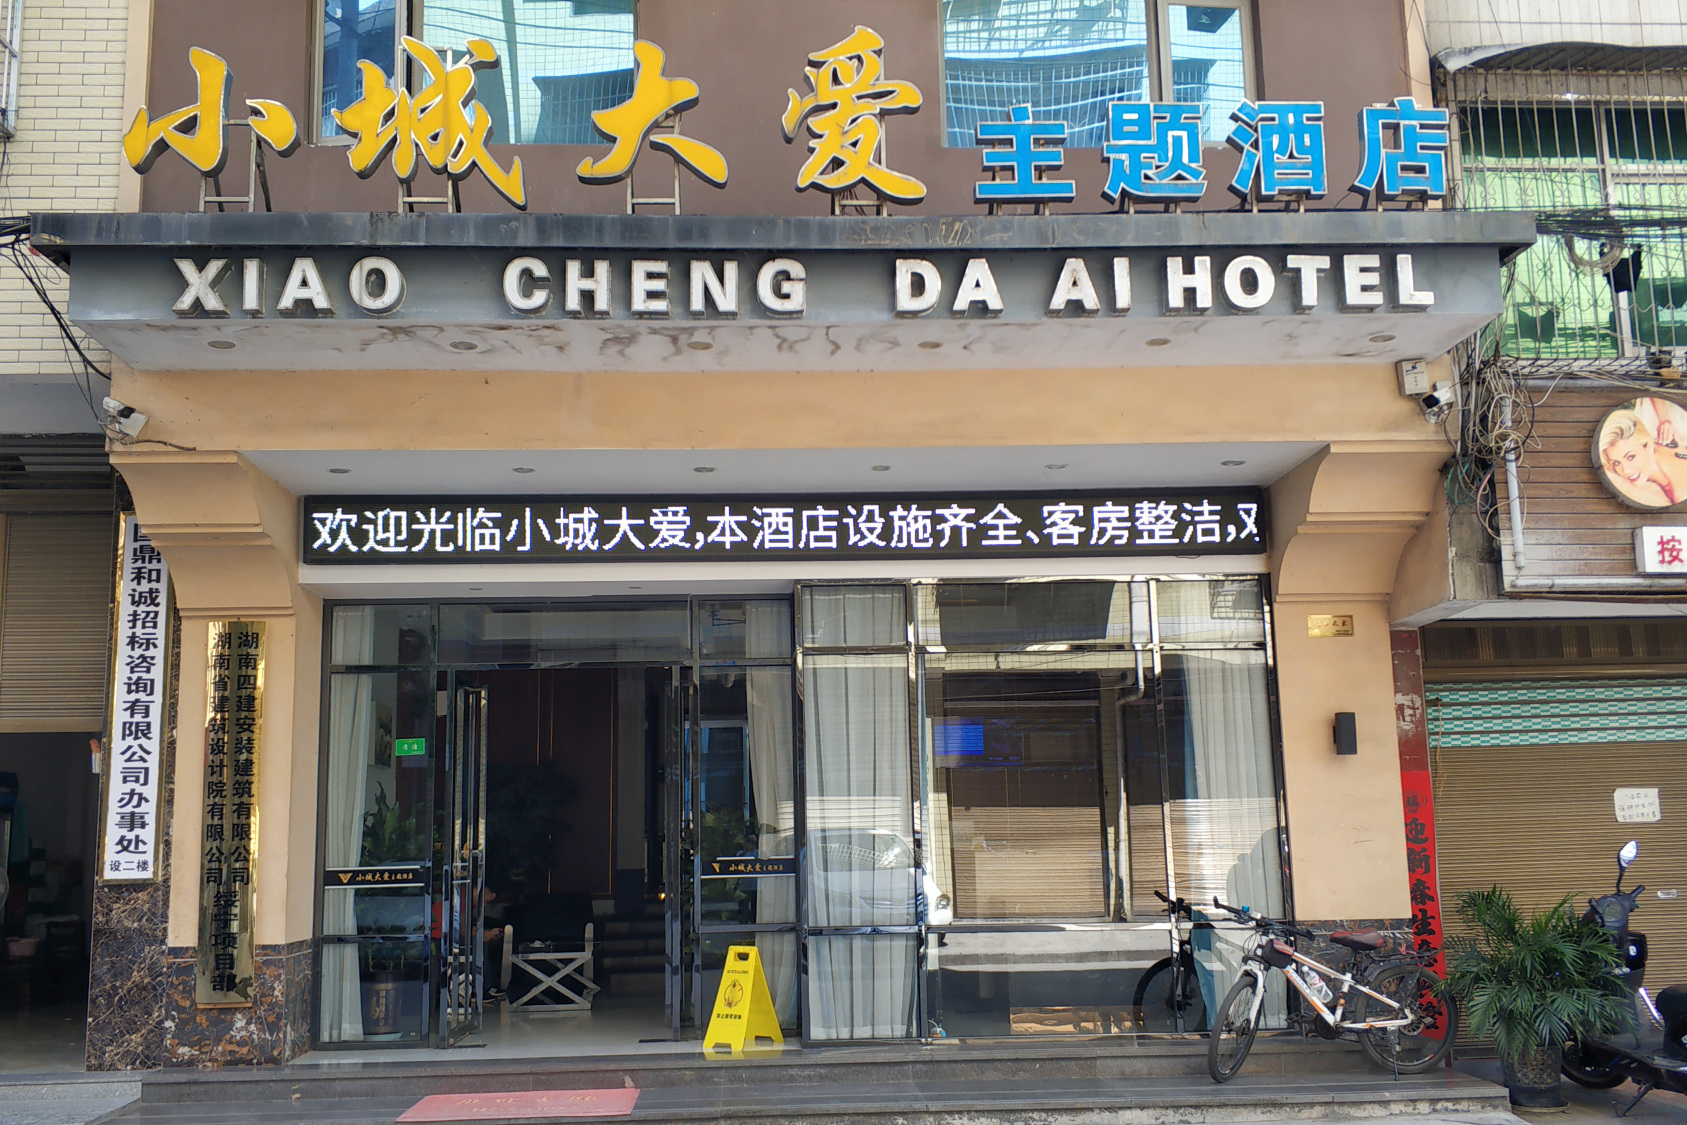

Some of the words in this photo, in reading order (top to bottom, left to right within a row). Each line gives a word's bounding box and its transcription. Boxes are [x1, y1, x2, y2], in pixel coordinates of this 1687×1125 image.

[122, 25, 927, 211] 小城大爱
[974, 97, 1450, 205] 主题酒店
[171, 256, 406, 318] XIAO
[502, 256, 808, 317] CHENG
[894, 256, 1004, 317] DA
[1048, 256, 1131, 316] AI
[1164, 253, 1436, 313] HOTEL
[1657, 535, 1685, 565] 按
[205, 632, 232, 886] 湖南省建筑设计院有限公司
[231, 631, 260, 886] 湖南四建安装建筑有限公司
[109, 859, 150, 873] 设二楼
